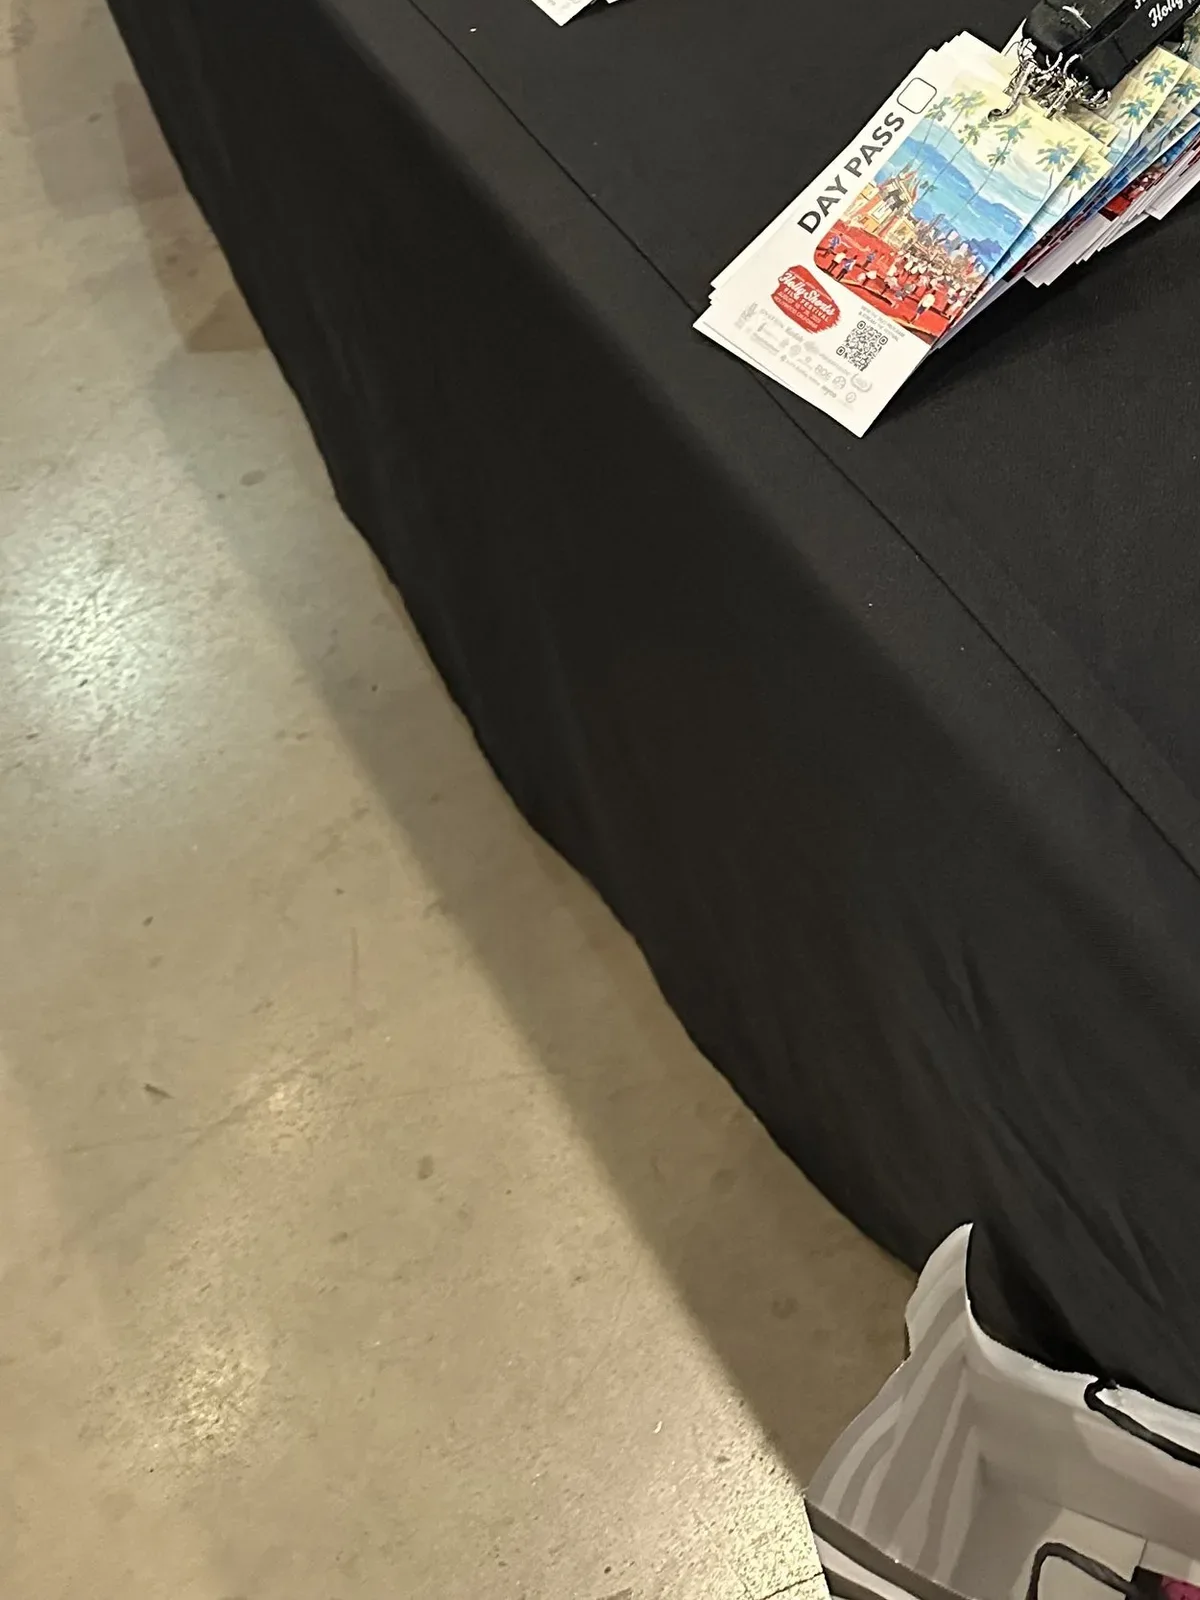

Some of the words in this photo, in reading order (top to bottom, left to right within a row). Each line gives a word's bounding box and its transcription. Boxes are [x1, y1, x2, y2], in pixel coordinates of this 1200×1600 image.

[797, 175, 849, 234] DAY
[844, 111, 905, 178] PASS
[777, 269, 836, 318] HollyShorts
[801, 296, 830, 323] FESTIVAL
